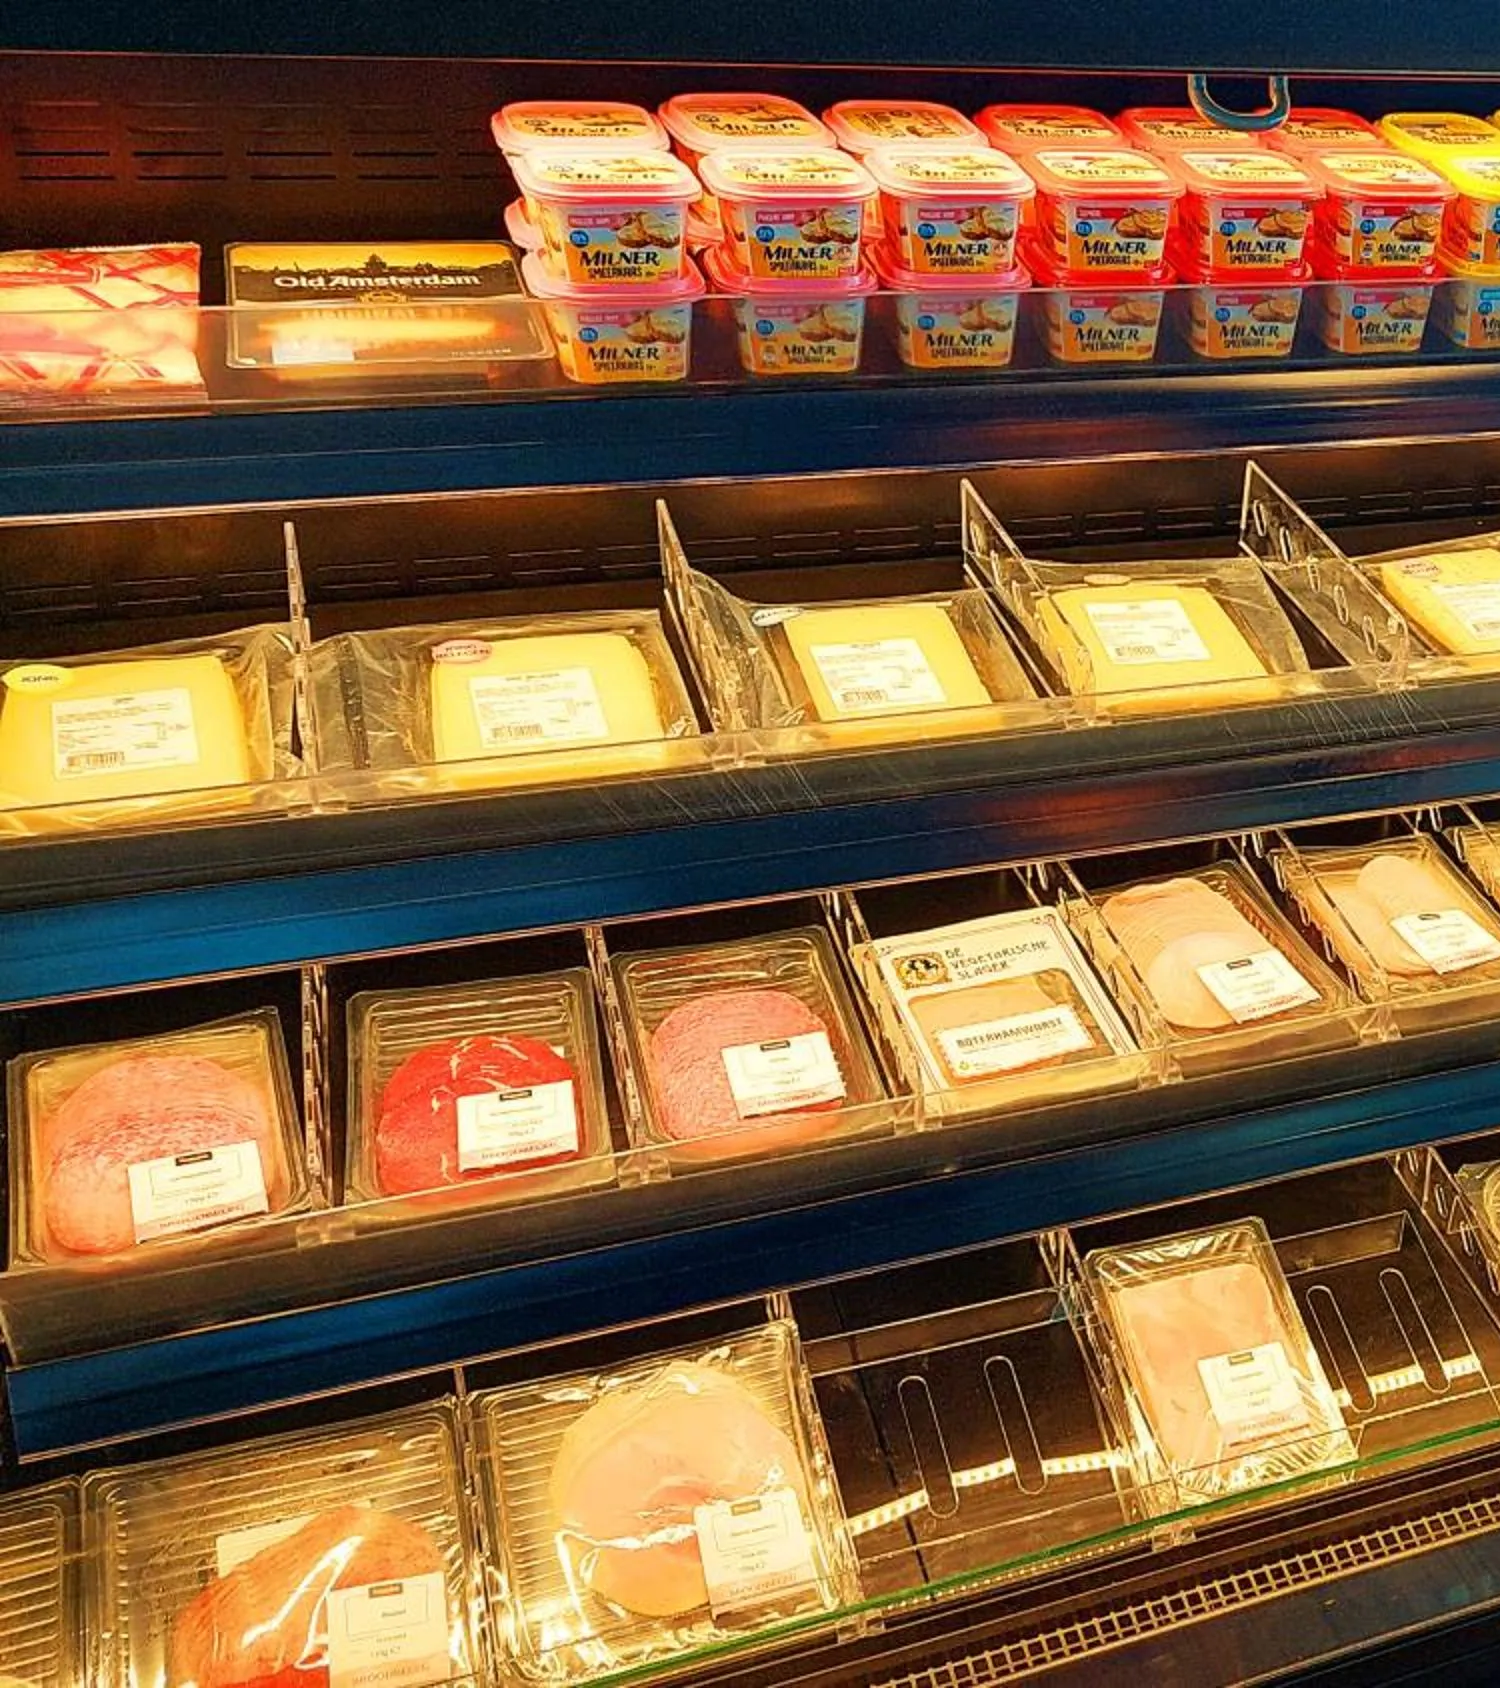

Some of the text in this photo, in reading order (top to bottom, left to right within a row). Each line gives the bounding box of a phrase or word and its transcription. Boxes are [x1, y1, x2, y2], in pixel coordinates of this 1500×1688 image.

[763, 245, 834, 262] MILNER
[923, 241, 989, 256] MILNER
[1080, 239, 1147, 255] MILNER
[1224, 239, 1287, 253] MILNER
[1377, 243, 1421, 254] MILNER
[580, 250, 661, 268] MILNER
[274, 273, 481, 288] Old Amsterdam
[1075, 327, 1140, 342] MILNER
[1219, 324, 1279, 338] MILNER
[1355, 321, 1413, 335] MILNER
[925, 332, 993, 347] MILNER
[587, 346, 659, 362] MILNER
[781, 345, 837, 357] MILNER
[950, 939, 1051, 968] VEGETARISCHE
[956, 960, 1012, 980] SLAGER
